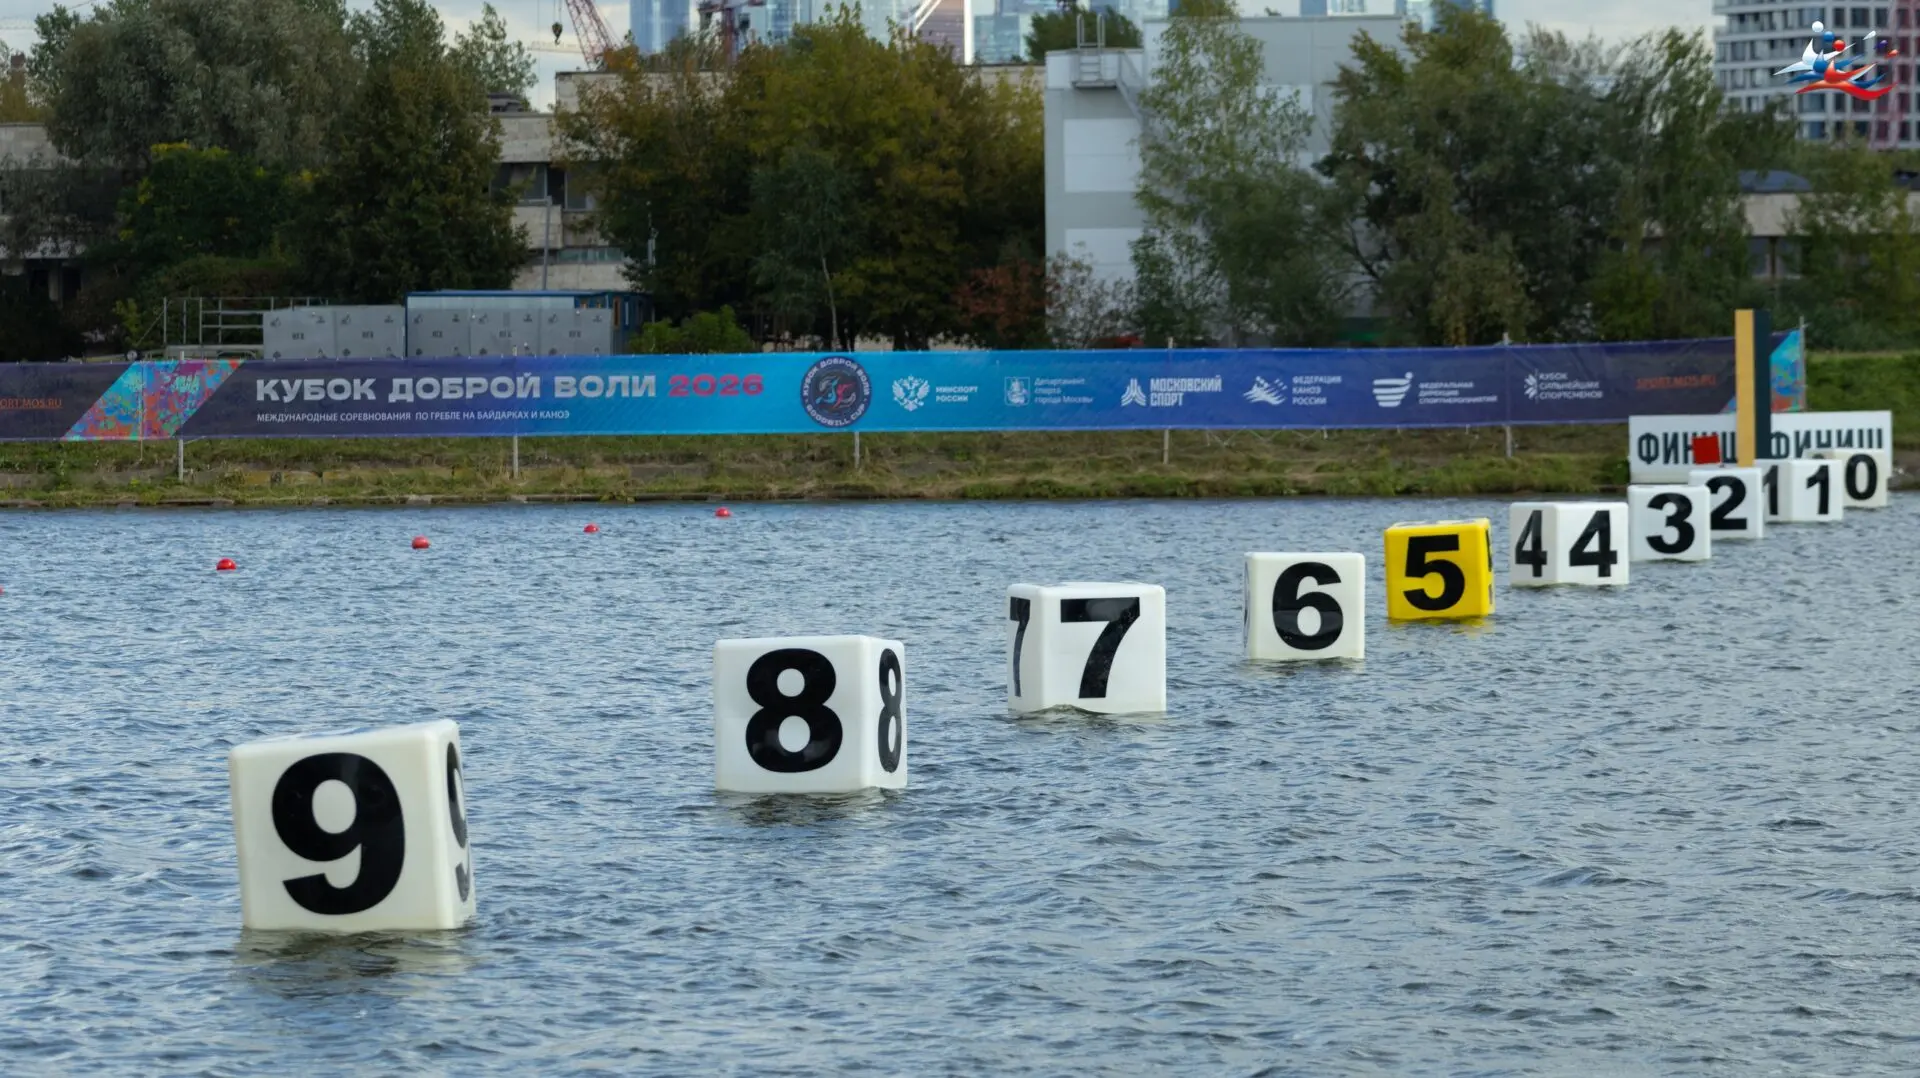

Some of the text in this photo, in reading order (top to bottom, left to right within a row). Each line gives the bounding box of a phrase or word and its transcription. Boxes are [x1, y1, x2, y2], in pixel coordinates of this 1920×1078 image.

[256, 372, 765, 403] КУБОК ДОБРОЙ ВОЛИ 2026
[803, 366, 820, 397] КУБОК
[935, 386, 978, 394] МИНСПОРТ
[1150, 374, 1222, 392] МОСКОВСКИЙ
[1150, 392, 1184, 407] СПОРТ
[1292, 375, 1342, 384] ФЕДЕРАЦИЯ
[1292, 386, 1322, 395] КАНОЭ
[1292, 396, 1327, 405] РОССИИ
[1539, 372, 1568, 381] КУБОК
[1539, 390, 1603, 399] СПОРТСМЕНОВ
[256, 409, 570, 422] МЕЖДУНАРОДНЫЕ СОРЕВНОВАНИЯ ПО ГРЕБЛЕ НА БАЙДАРКАХ И КАНОЭ
[805, 403, 866, 427] GOODWILL CUP
[1637, 432, 1738, 465] ФИНШ
[1762, 464, 1779, 516] 1
[1806, 464, 1830, 515] 1
[1845, 453, 1878, 501] 0
[1646, 492, 1695, 554] 3
[1705, 475, 1748, 531] 2
[1515, 510, 1547, 577] 4
[1569, 510, 1618, 577] 4
[1403, 534, 1466, 611] 5
[1272, 561, 1344, 651] 6
[1009, 596, 1031, 697] 7
[1060, 596, 1141, 699] 7
[745, 648, 843, 773] 8
[878, 648, 902, 773] 8
[272, 752, 406, 916] 9
[446, 741, 471, 903] 9
